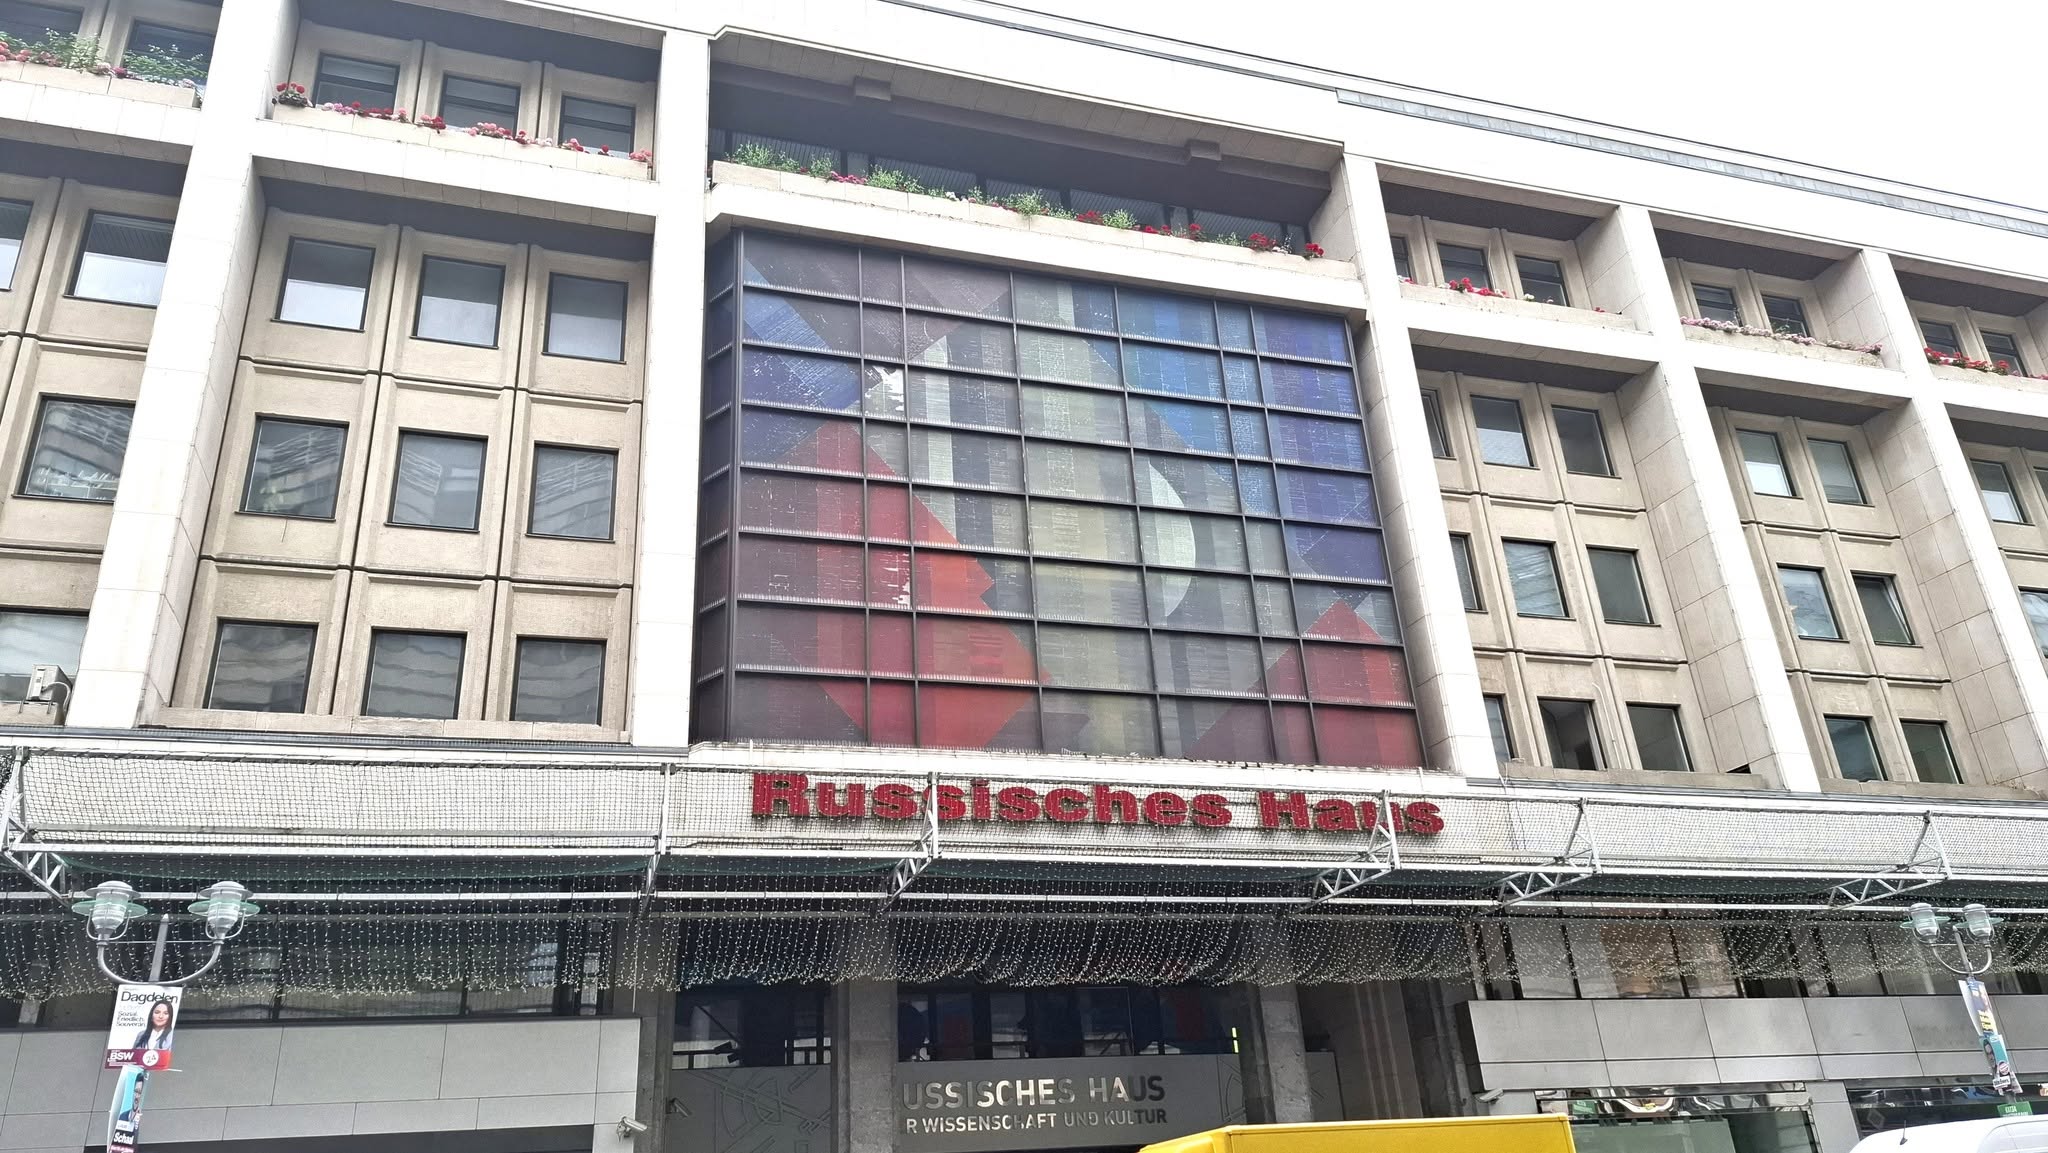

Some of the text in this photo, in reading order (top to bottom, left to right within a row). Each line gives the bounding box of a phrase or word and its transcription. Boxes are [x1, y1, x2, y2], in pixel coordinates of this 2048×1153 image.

[752, 771, 1445, 834] Russisches Haus
[121, 991, 178, 1004] Dagdelen
[110, 1051, 134, 1061] BSW
[903, 1075, 1166, 1110] USSISCHES HAUS
[906, 1108, 1168, 1134] R WISSENSCHAFT UND KULTUR
